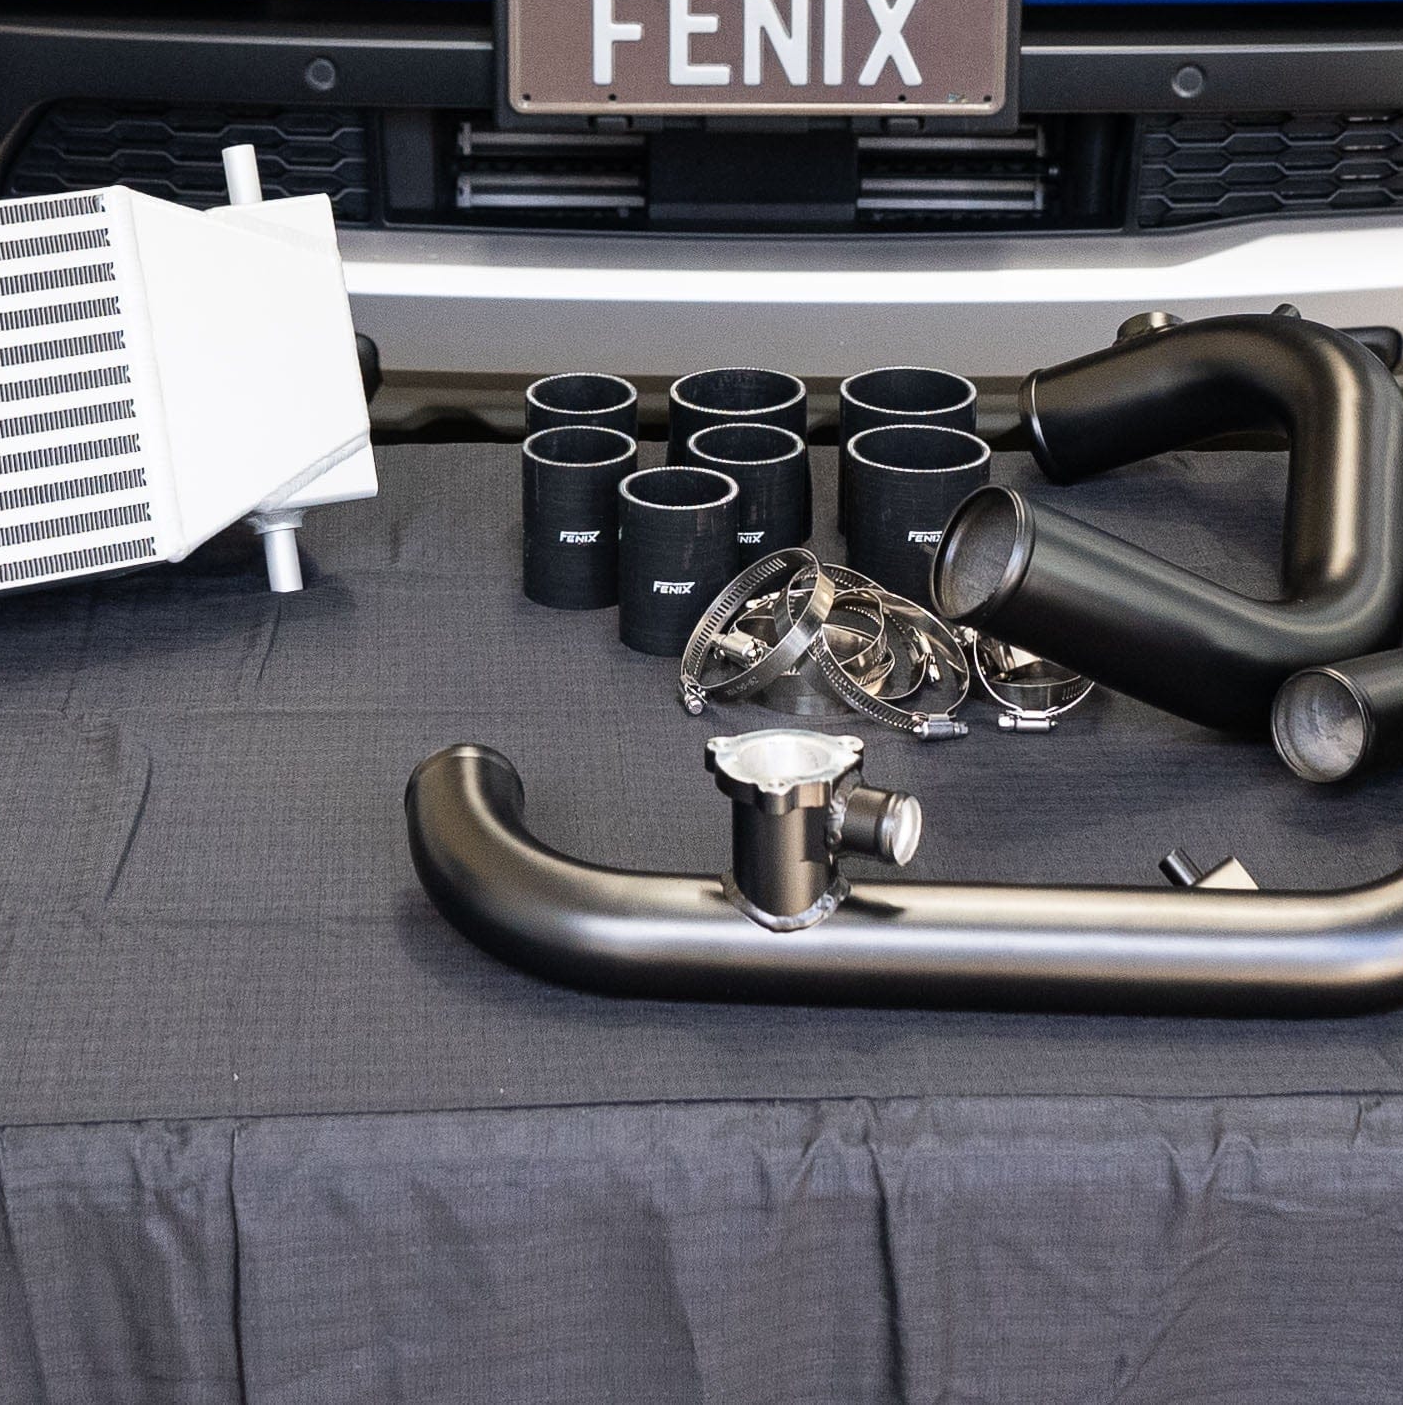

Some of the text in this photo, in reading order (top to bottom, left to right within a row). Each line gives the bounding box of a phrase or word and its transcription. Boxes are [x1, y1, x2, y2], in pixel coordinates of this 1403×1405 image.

[559, 530, 600, 543] FENIX
[737, 531, 765, 544] NIX
[653, 580, 696, 595] FENIX
